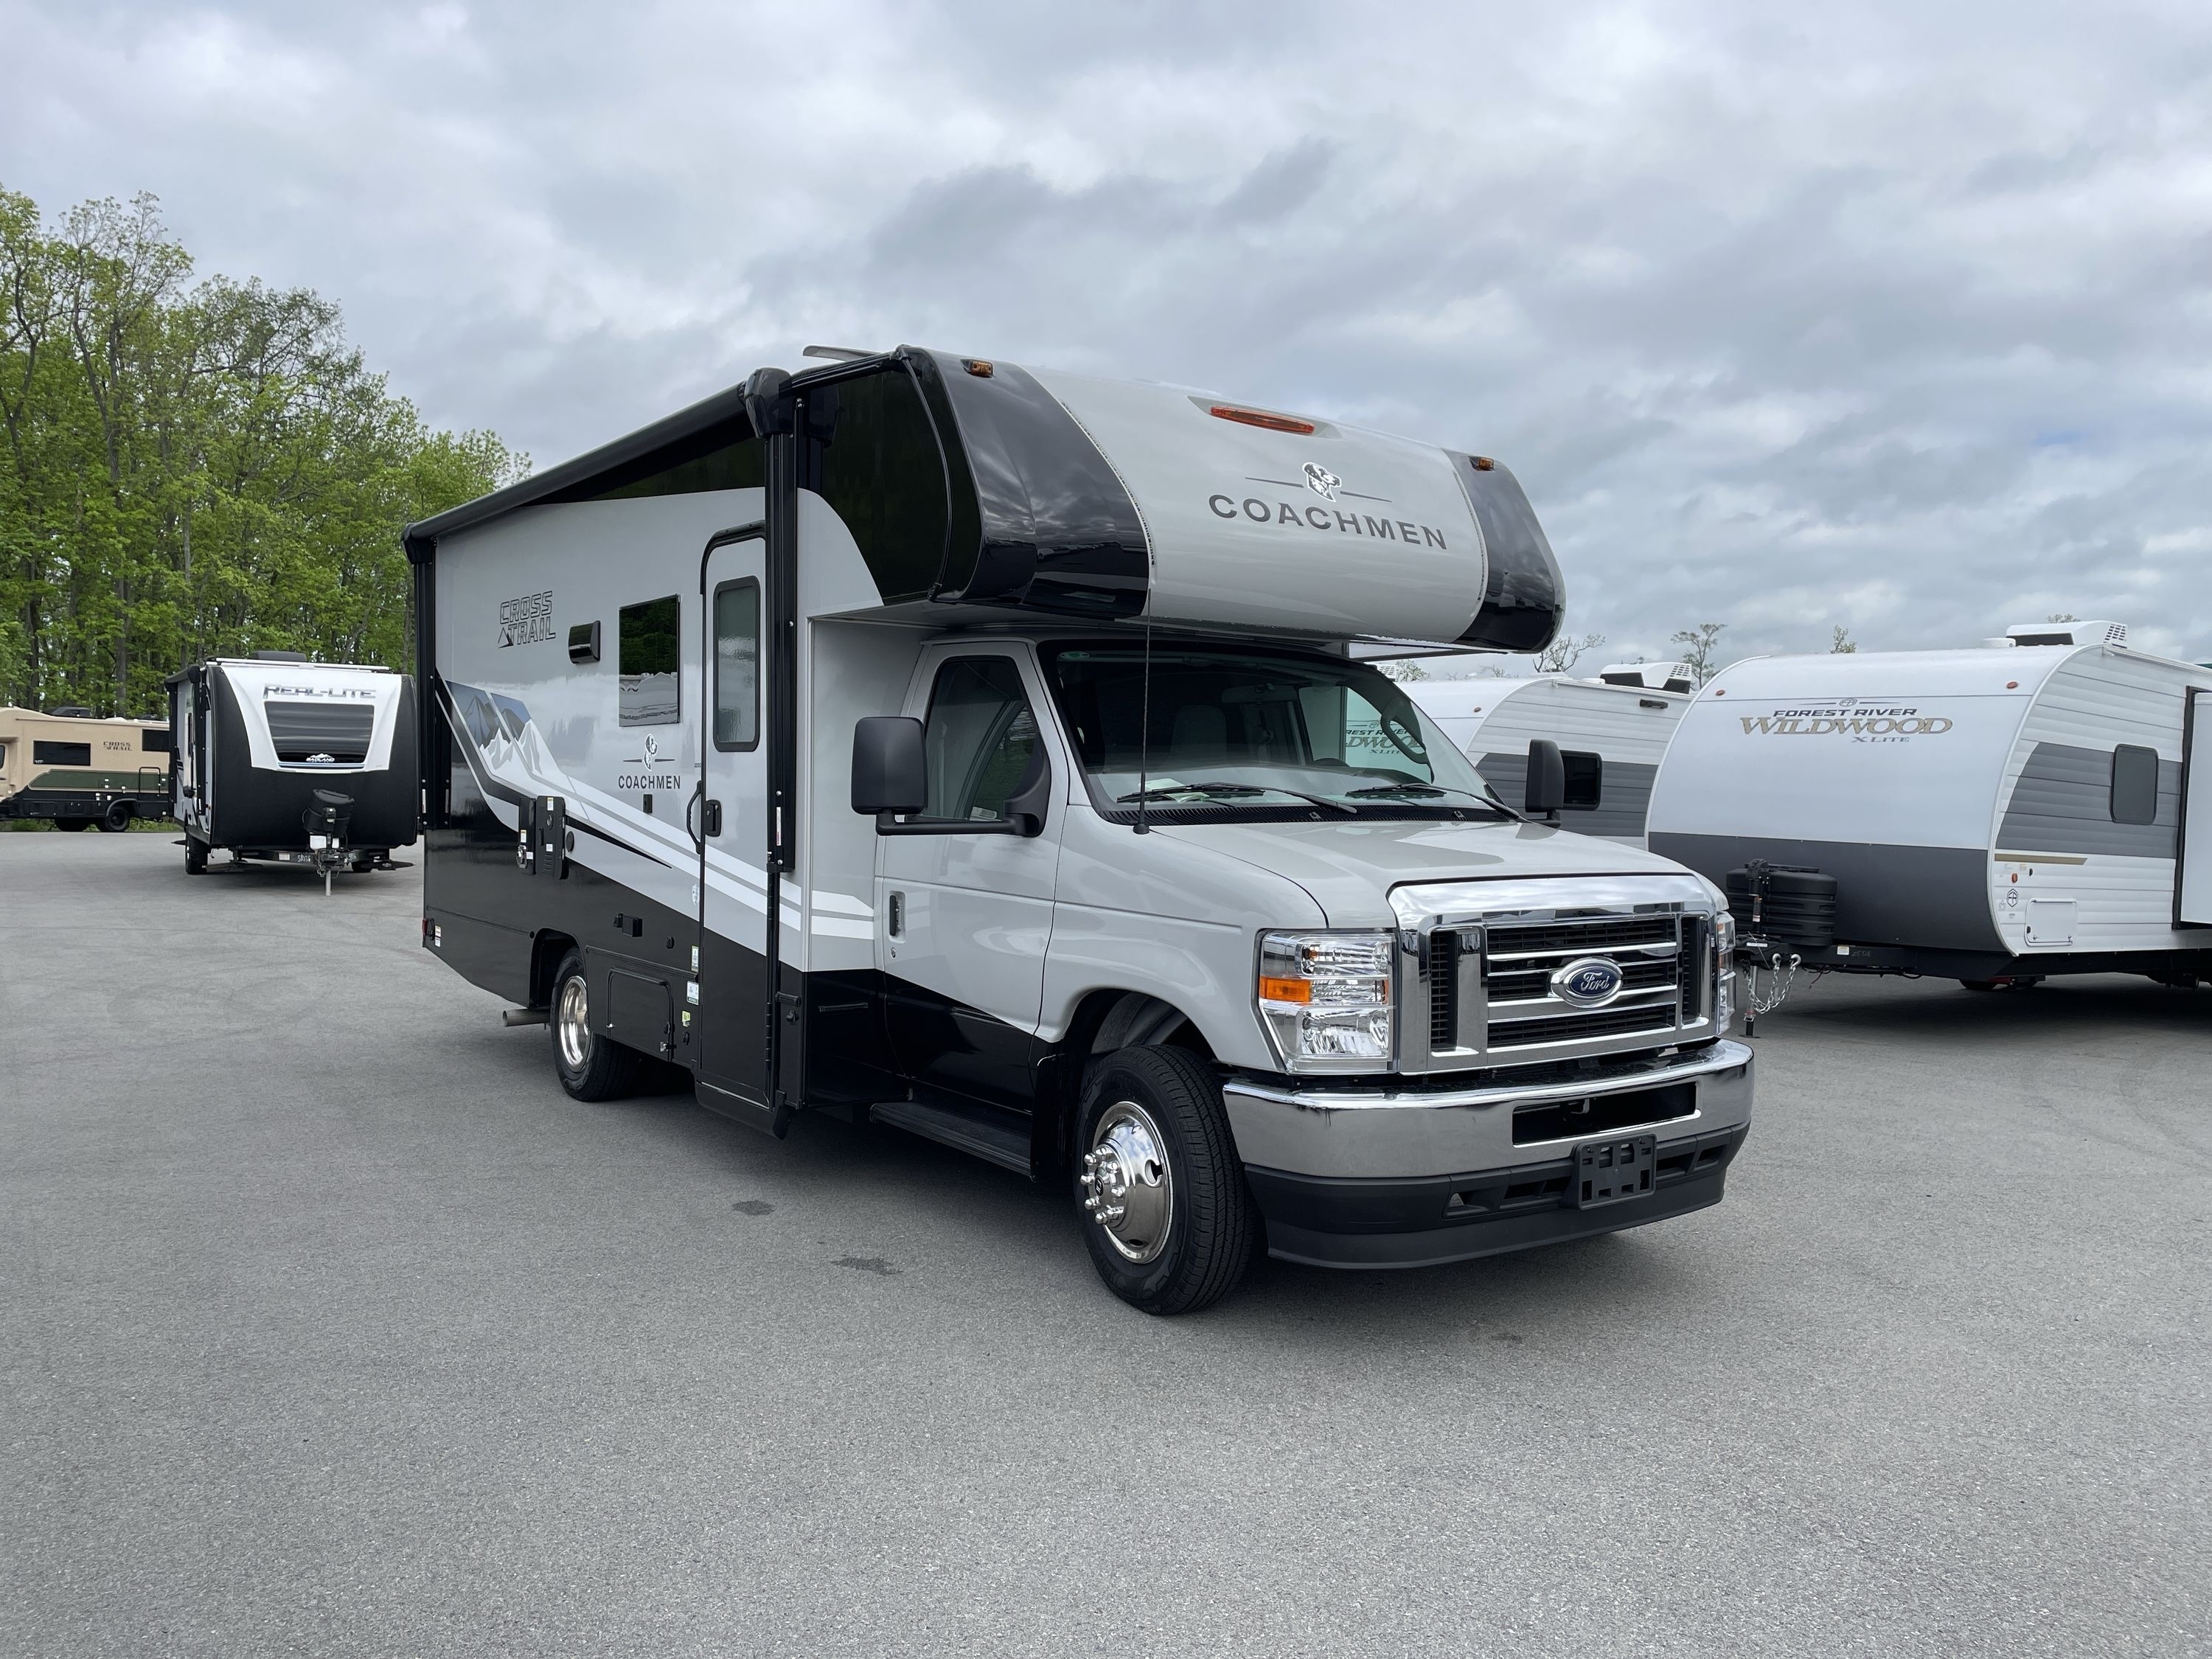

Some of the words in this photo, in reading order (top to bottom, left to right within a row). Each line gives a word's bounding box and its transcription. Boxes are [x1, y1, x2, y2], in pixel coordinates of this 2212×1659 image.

[1208, 494, 1447, 550] COACHMEN
[500, 591, 552, 625] CROSS
[508, 616, 556, 646] TRAIL
[1773, 709, 1851, 717] FOREST
[1739, 717, 1953, 735] WILDWOOD
[618, 775, 681, 789] COACHMEN
[1580, 972, 1610, 992] Ford
